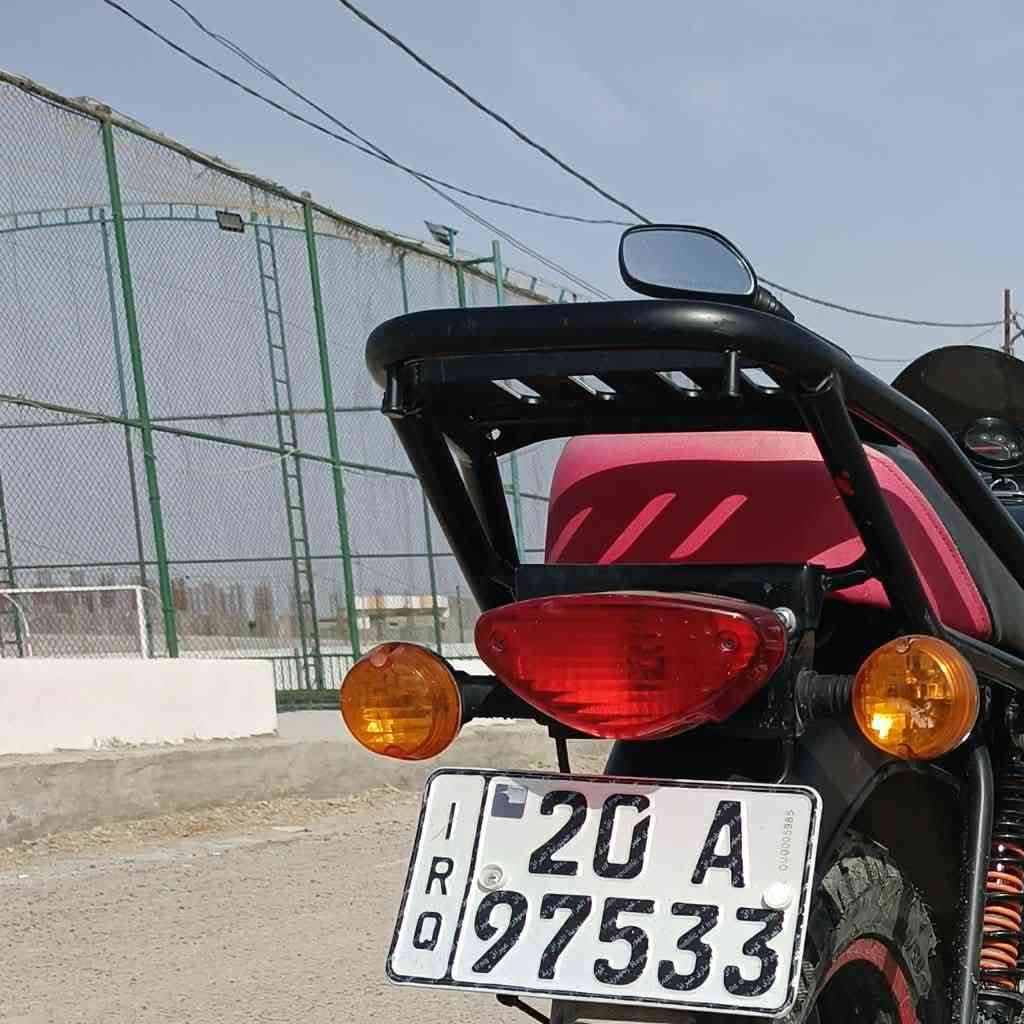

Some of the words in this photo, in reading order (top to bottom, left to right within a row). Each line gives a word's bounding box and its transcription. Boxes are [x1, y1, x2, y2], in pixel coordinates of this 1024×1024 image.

[528, 790, 651, 880] 20
[690, 799, 745, 888] A
[472, 890, 785, 997] 97533
